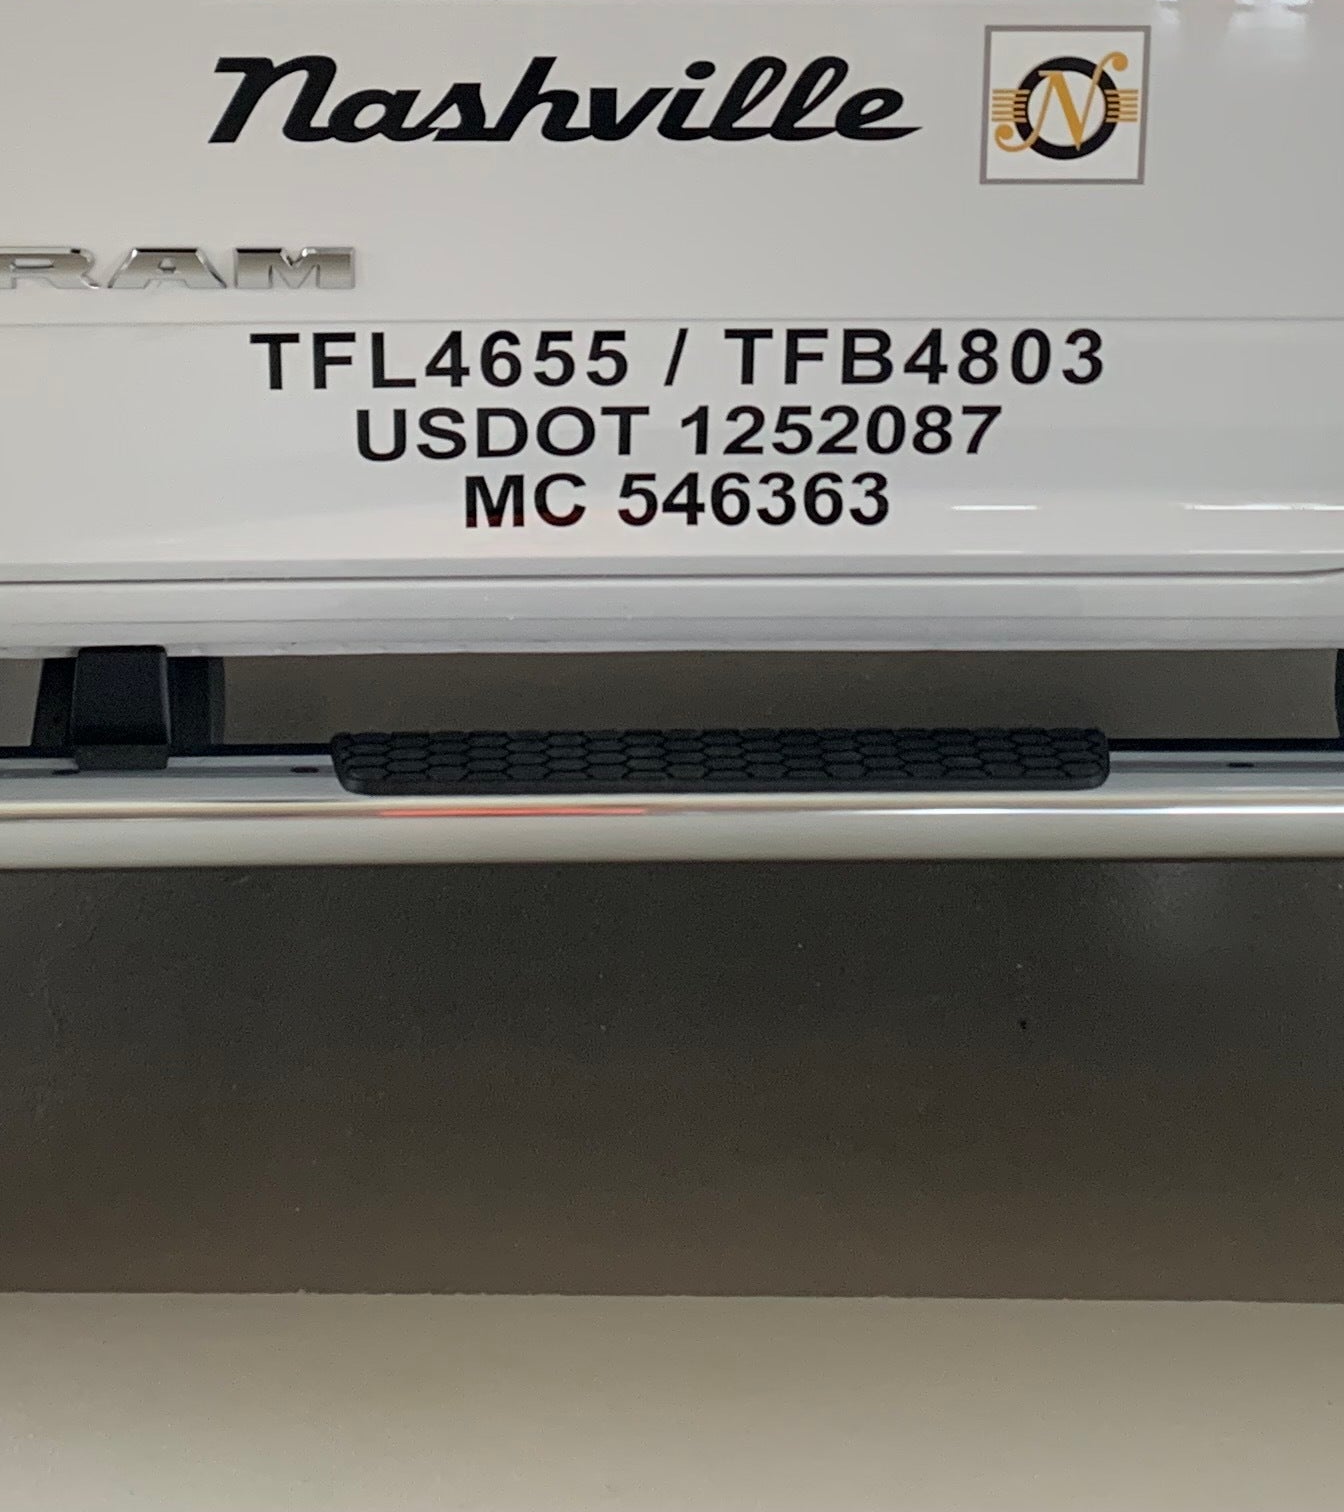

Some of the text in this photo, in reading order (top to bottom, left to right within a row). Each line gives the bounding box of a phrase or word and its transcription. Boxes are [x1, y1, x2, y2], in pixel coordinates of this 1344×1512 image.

[207, 55, 924, 144] Nashville
[249, 327, 1104, 391] TFL4655 / TFB4803
[356, 404, 1003, 462] USDOT 1252087
[465, 471, 889, 528] MC 546363
